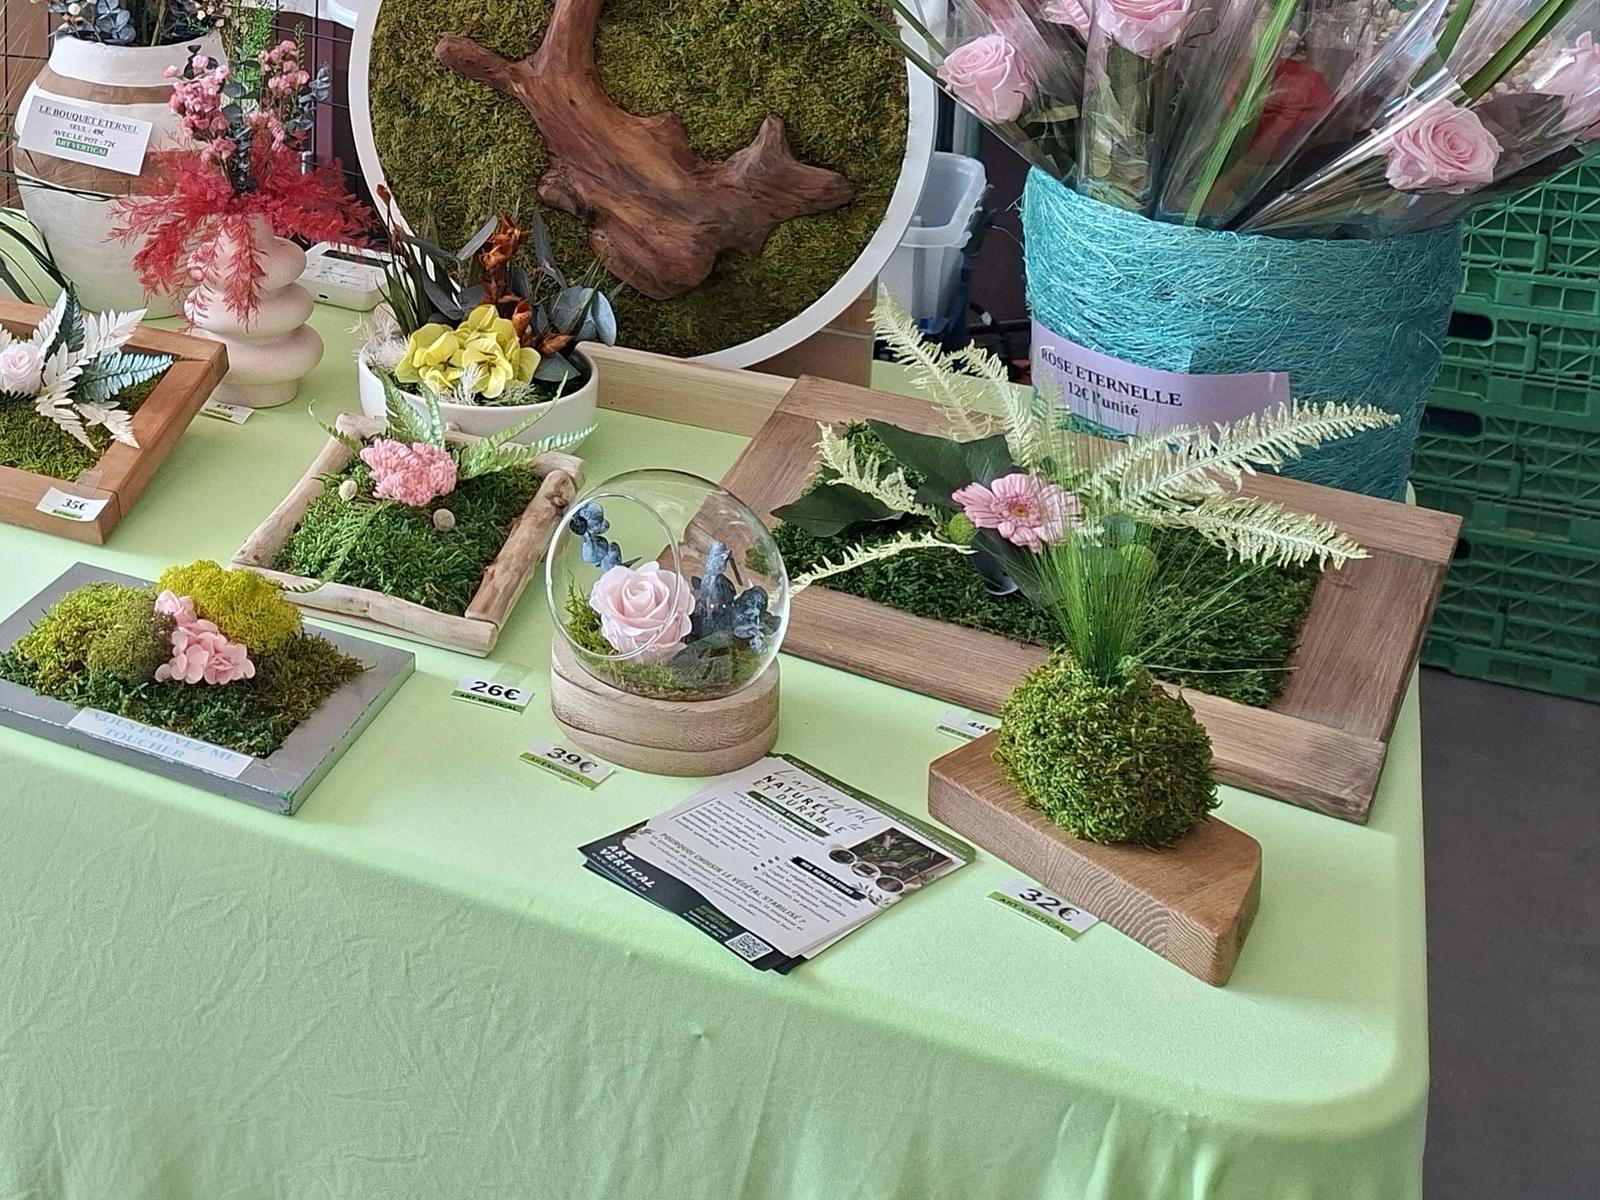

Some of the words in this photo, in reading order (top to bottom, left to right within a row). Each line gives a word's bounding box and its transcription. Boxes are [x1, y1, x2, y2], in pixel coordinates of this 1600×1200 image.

[38, 104, 51, 115] LE
[52, 107, 98, 125] BOUQUET
[99, 118, 140, 134] ETERNEL
[69, 123, 87, 133] SEUL
[52, 129, 72, 139] AVEC
[84, 135, 99, 145] POT
[1041, 348, 1073, 375] ROSE
[1075, 364, 1183, 407] ETERNELLE
[1068, 381, 1091, 401] 12€
[61, 498, 90, 511] 35€
[470, 681, 521, 701] 26€
[93, 711, 135, 732] VOUS
[139, 725, 205, 753] POUVEZ
[206, 747, 237, 762] ME
[103, 726, 186, 760] TOUCHER
[546, 747, 598, 774] 39€
[751, 779, 773, 791] ET
[775, 791, 846, 833] DURABLE
[762, 775, 829, 815] NATUREL
[599, 847, 655, 888] VERTICAL
[605, 845, 634, 860] ART
[999, 898, 1020, 909] ART
[1020, 907, 1066, 933] VERTICAL
[1018, 888, 1081, 922] 32€
